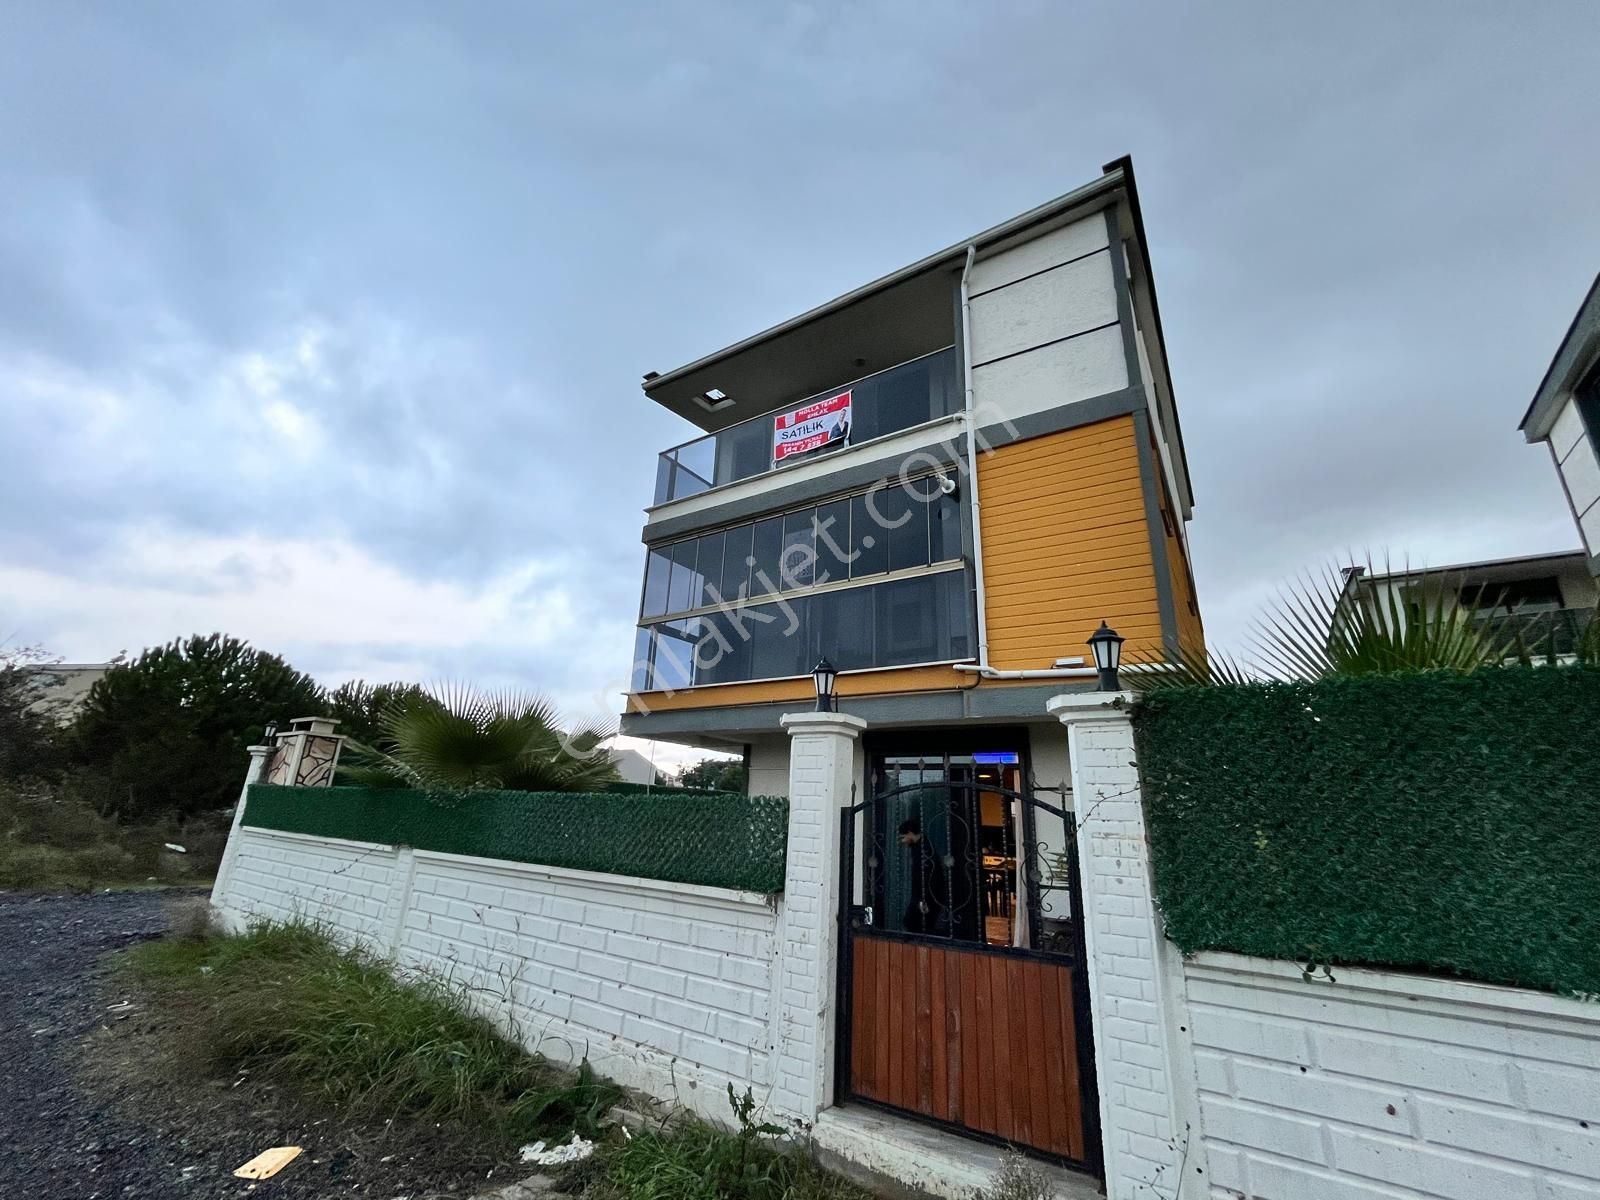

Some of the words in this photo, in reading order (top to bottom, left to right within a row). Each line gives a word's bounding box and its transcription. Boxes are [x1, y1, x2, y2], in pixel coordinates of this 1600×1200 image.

[821, 399, 838, 408] TEAM
[807, 407, 829, 418] EMLAK
[781, 420, 823, 439] SATILIK
